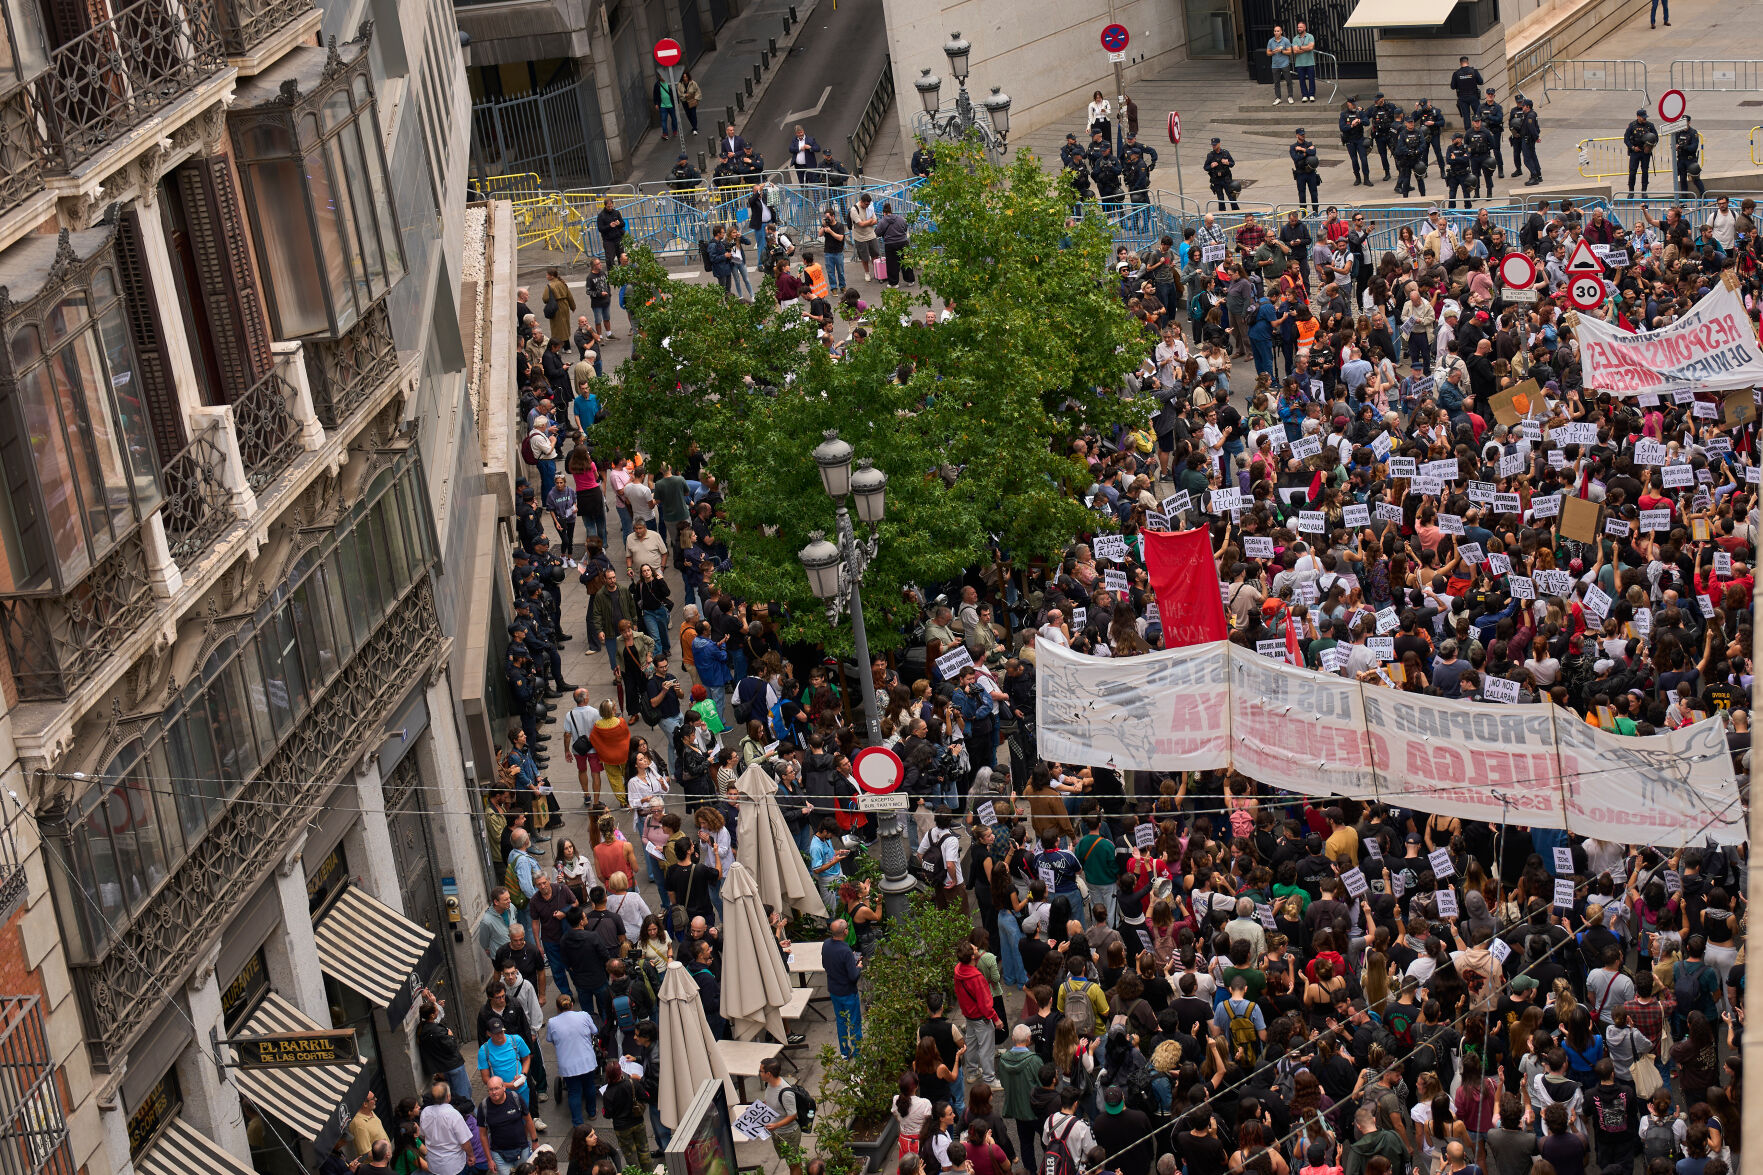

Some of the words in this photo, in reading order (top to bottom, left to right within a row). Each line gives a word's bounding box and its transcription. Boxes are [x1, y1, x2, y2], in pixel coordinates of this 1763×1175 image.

[1576, 286, 1598, 298] 30
[1574, 424, 1590, 433] SIN
[1570, 432, 1596, 445] TECHO!
[1641, 444, 1658, 453] SIN
[1390, 458, 1415, 467] ¡DERECHO
[1505, 456, 1518, 466] SIN
[1636, 454, 1664, 465] TECHO!
[1397, 468, 1415, 476] TECHO!
[1502, 462, 1524, 477] TECHO!
[1216, 489, 1233, 499] SIN
[1494, 494, 1518, 503] ¡DERECHO
[1165, 492, 1188, 507] ¡DERECHO
[1213, 497, 1241, 511] TECHO!
[1533, 496, 1551, 507] ROBAN
[1172, 501, 1190, 514] TECHO!
[1500, 504, 1519, 512] TECHO!
[1300, 513, 1324, 521] ACAMPADA
[1300, 523, 1311, 531] PRO
[1097, 536, 1123, 545] ALOJAR
[1245, 538, 1262, 546] ROBAN
[1098, 549, 1124, 558] ALEJAR
[1513, 588, 1533, 599] ¡NO!
[1369, 638, 1375, 648] SU
[1375, 638, 1392, 648] BURBUJA
[1376, 650, 1392, 659] ESTALLA
[1488, 680, 1500, 688] ¡NO
[1503, 682, 1515, 691] NOS
[259, 1042, 278, 1054] EL
[281, 1039, 335, 1052] BARRIL
[261, 1054, 275, 1063] DE
[276, 1053, 296, 1062] LAS
[297, 1051, 335, 1062] CORTES
[746, 1112, 775, 1138] ¡NO!
